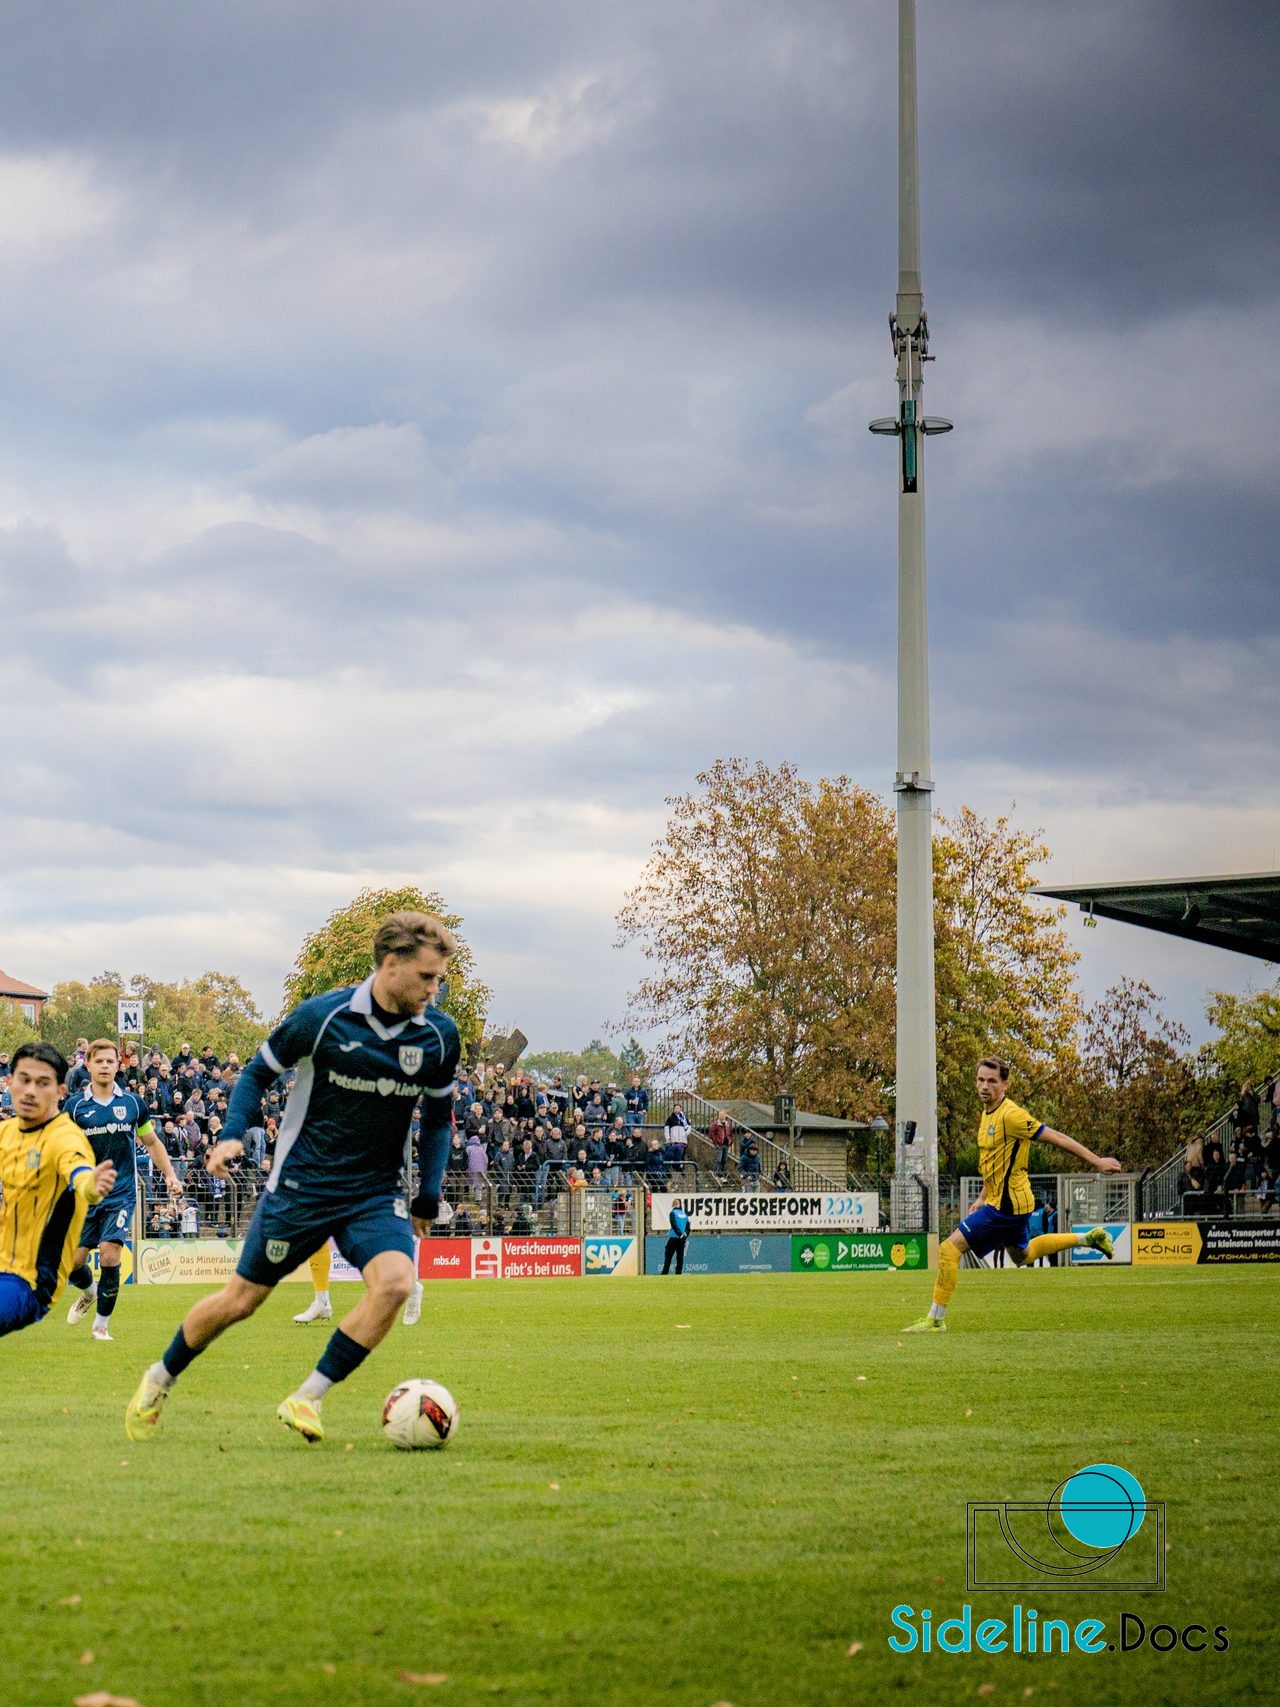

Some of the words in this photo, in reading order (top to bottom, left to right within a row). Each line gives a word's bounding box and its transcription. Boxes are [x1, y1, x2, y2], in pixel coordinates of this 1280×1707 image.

[328, 1070, 376, 1093] Potsdam
[1073, 1187, 1086, 1200] 12
[677, 1198, 821, 1217] UFSTIEGSREFORM
[117, 1209, 127, 1228] 6
[504, 1242, 580, 1257] Versicherungen
[851, 1244, 884, 1257] DEKRA
[1138, 1242, 1192, 1254] KÖNIG
[180, 1256, 195, 1264] Das
[433, 1255, 460, 1266] mbs.de
[586, 1244, 622, 1269] SAP
[148, 1256, 171, 1273] KLIMA
[179, 1268, 192, 1276] aus
[195, 1268, 212, 1276] dem
[534, 1260, 550, 1275] bei
[552, 1262, 574, 1275] uns.
